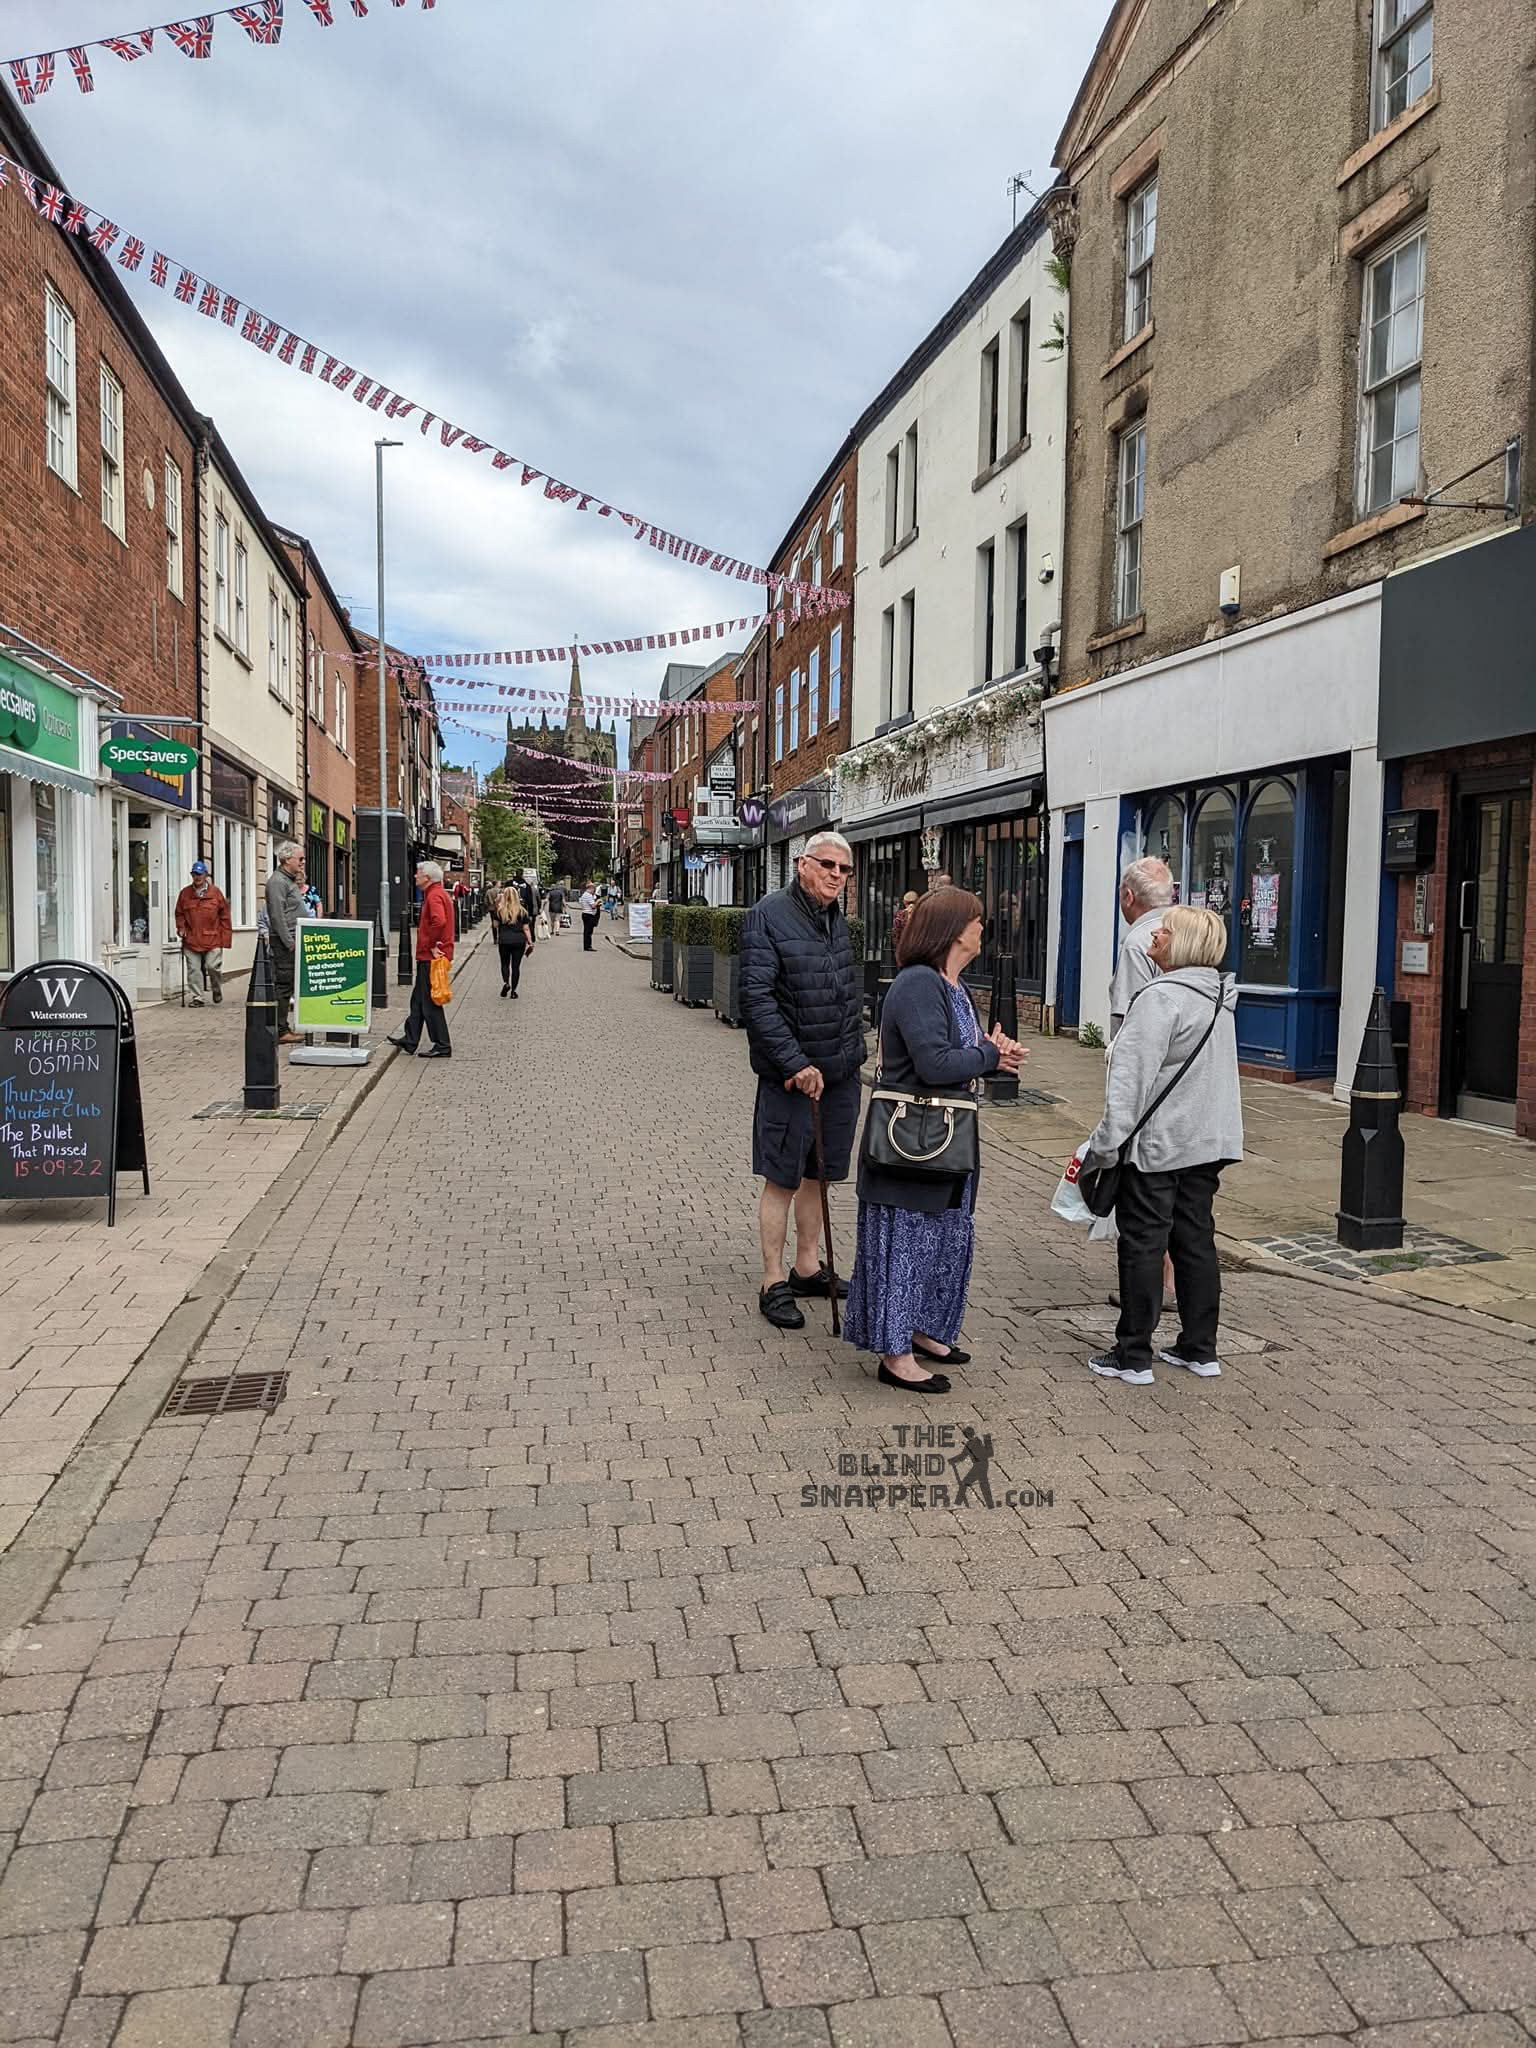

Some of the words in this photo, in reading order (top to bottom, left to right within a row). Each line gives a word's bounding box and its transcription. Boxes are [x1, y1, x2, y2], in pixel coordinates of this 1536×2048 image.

[0, 688, 36, 723] ecsavers
[109, 746, 188, 764] Specsavers
[303, 933, 330, 943] Bring
[304, 943, 313, 952] in
[316, 943, 338, 952] your
[305, 949, 365, 962] prescription
[327, 976, 347, 984] range
[37, 978, 84, 1008] W
[30, 1010, 88, 1020] Waterstones
[14, 1037, 97, 1055] RICHARD
[28, 1054, 100, 1075] OSMAN
[0, 1075, 74, 1104] Thursday
[4, 1104, 61, 1121] Murder
[62, 1103, 101, 1118] Club
[0, 1122, 24, 1143] The
[31, 1122, 73, 1141] Bullet
[10, 1143, 38, 1158] That
[43, 1142, 87, 1157] Missed
[14, 1159, 103, 1177] 15-09-22
